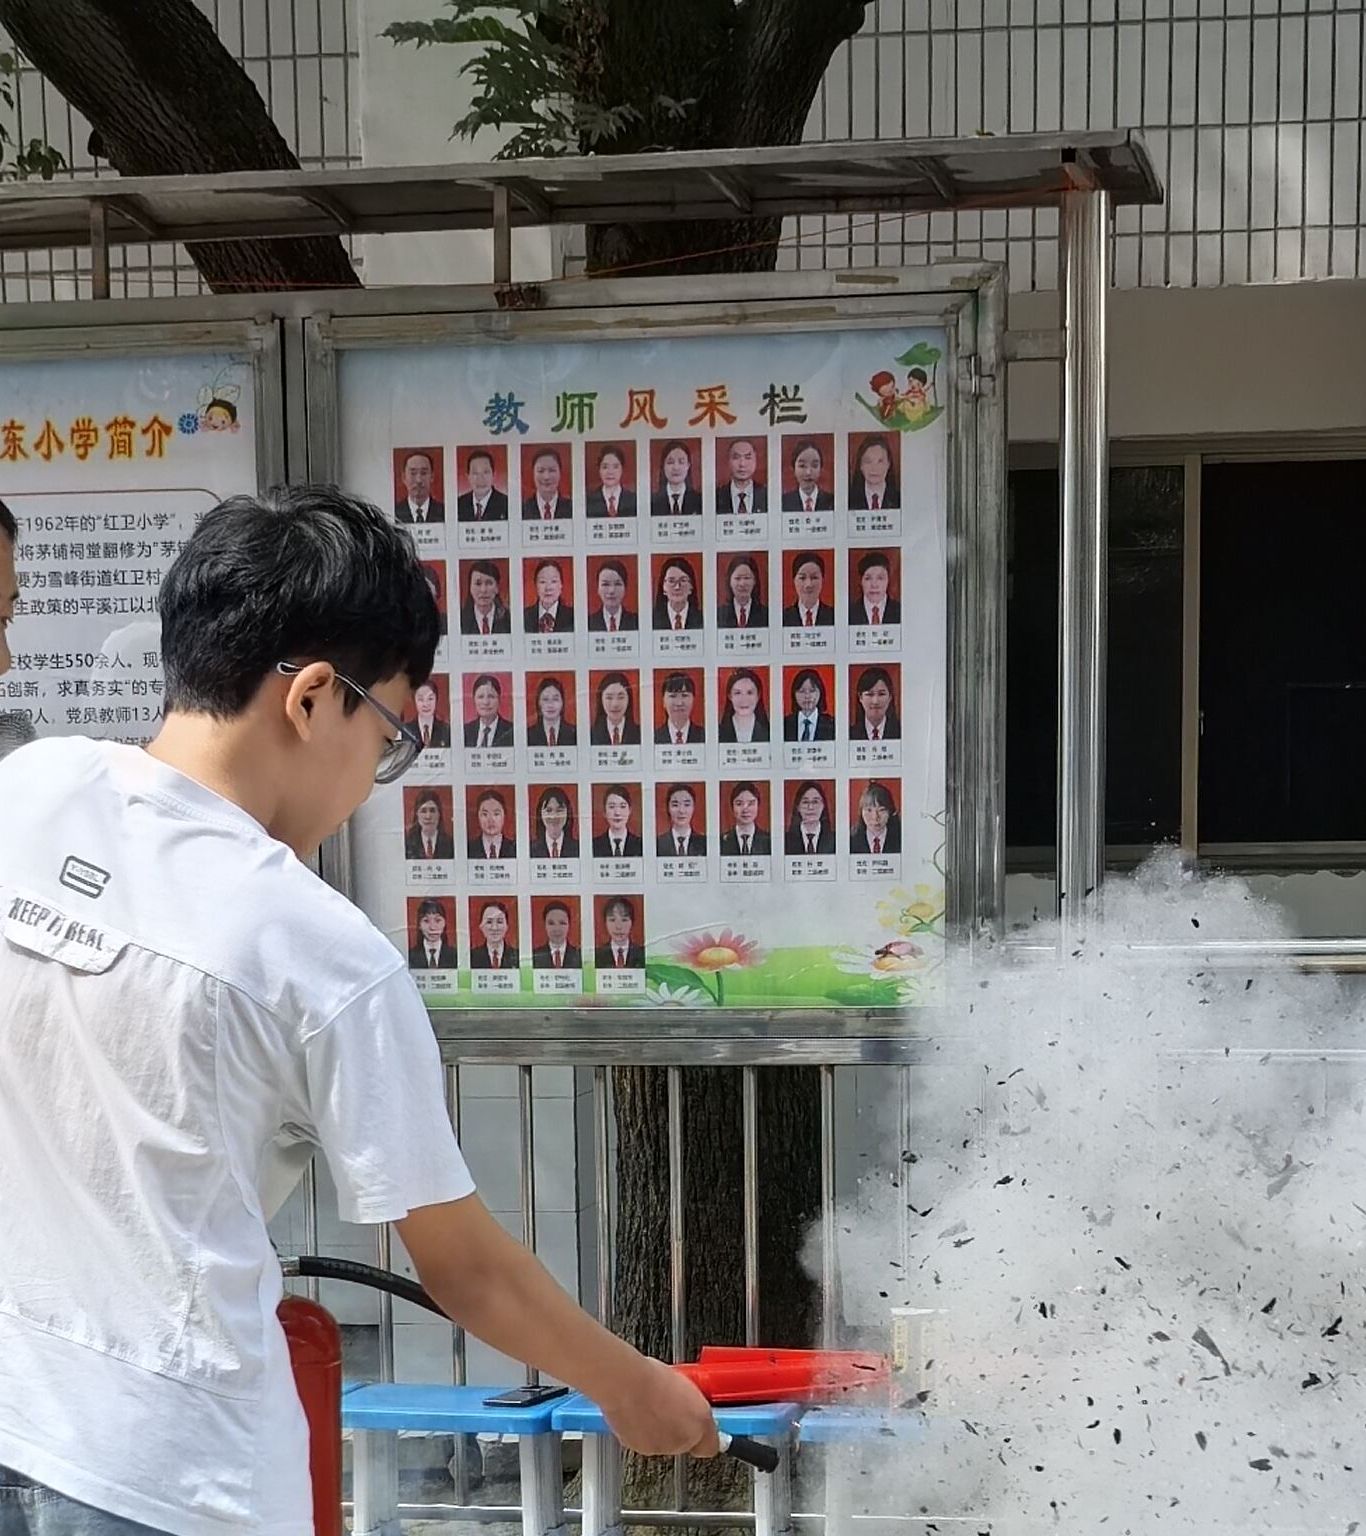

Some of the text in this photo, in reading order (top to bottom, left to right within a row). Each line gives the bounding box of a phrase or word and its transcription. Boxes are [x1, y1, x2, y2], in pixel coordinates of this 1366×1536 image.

[482, 382, 808, 435] 教师风采栏
